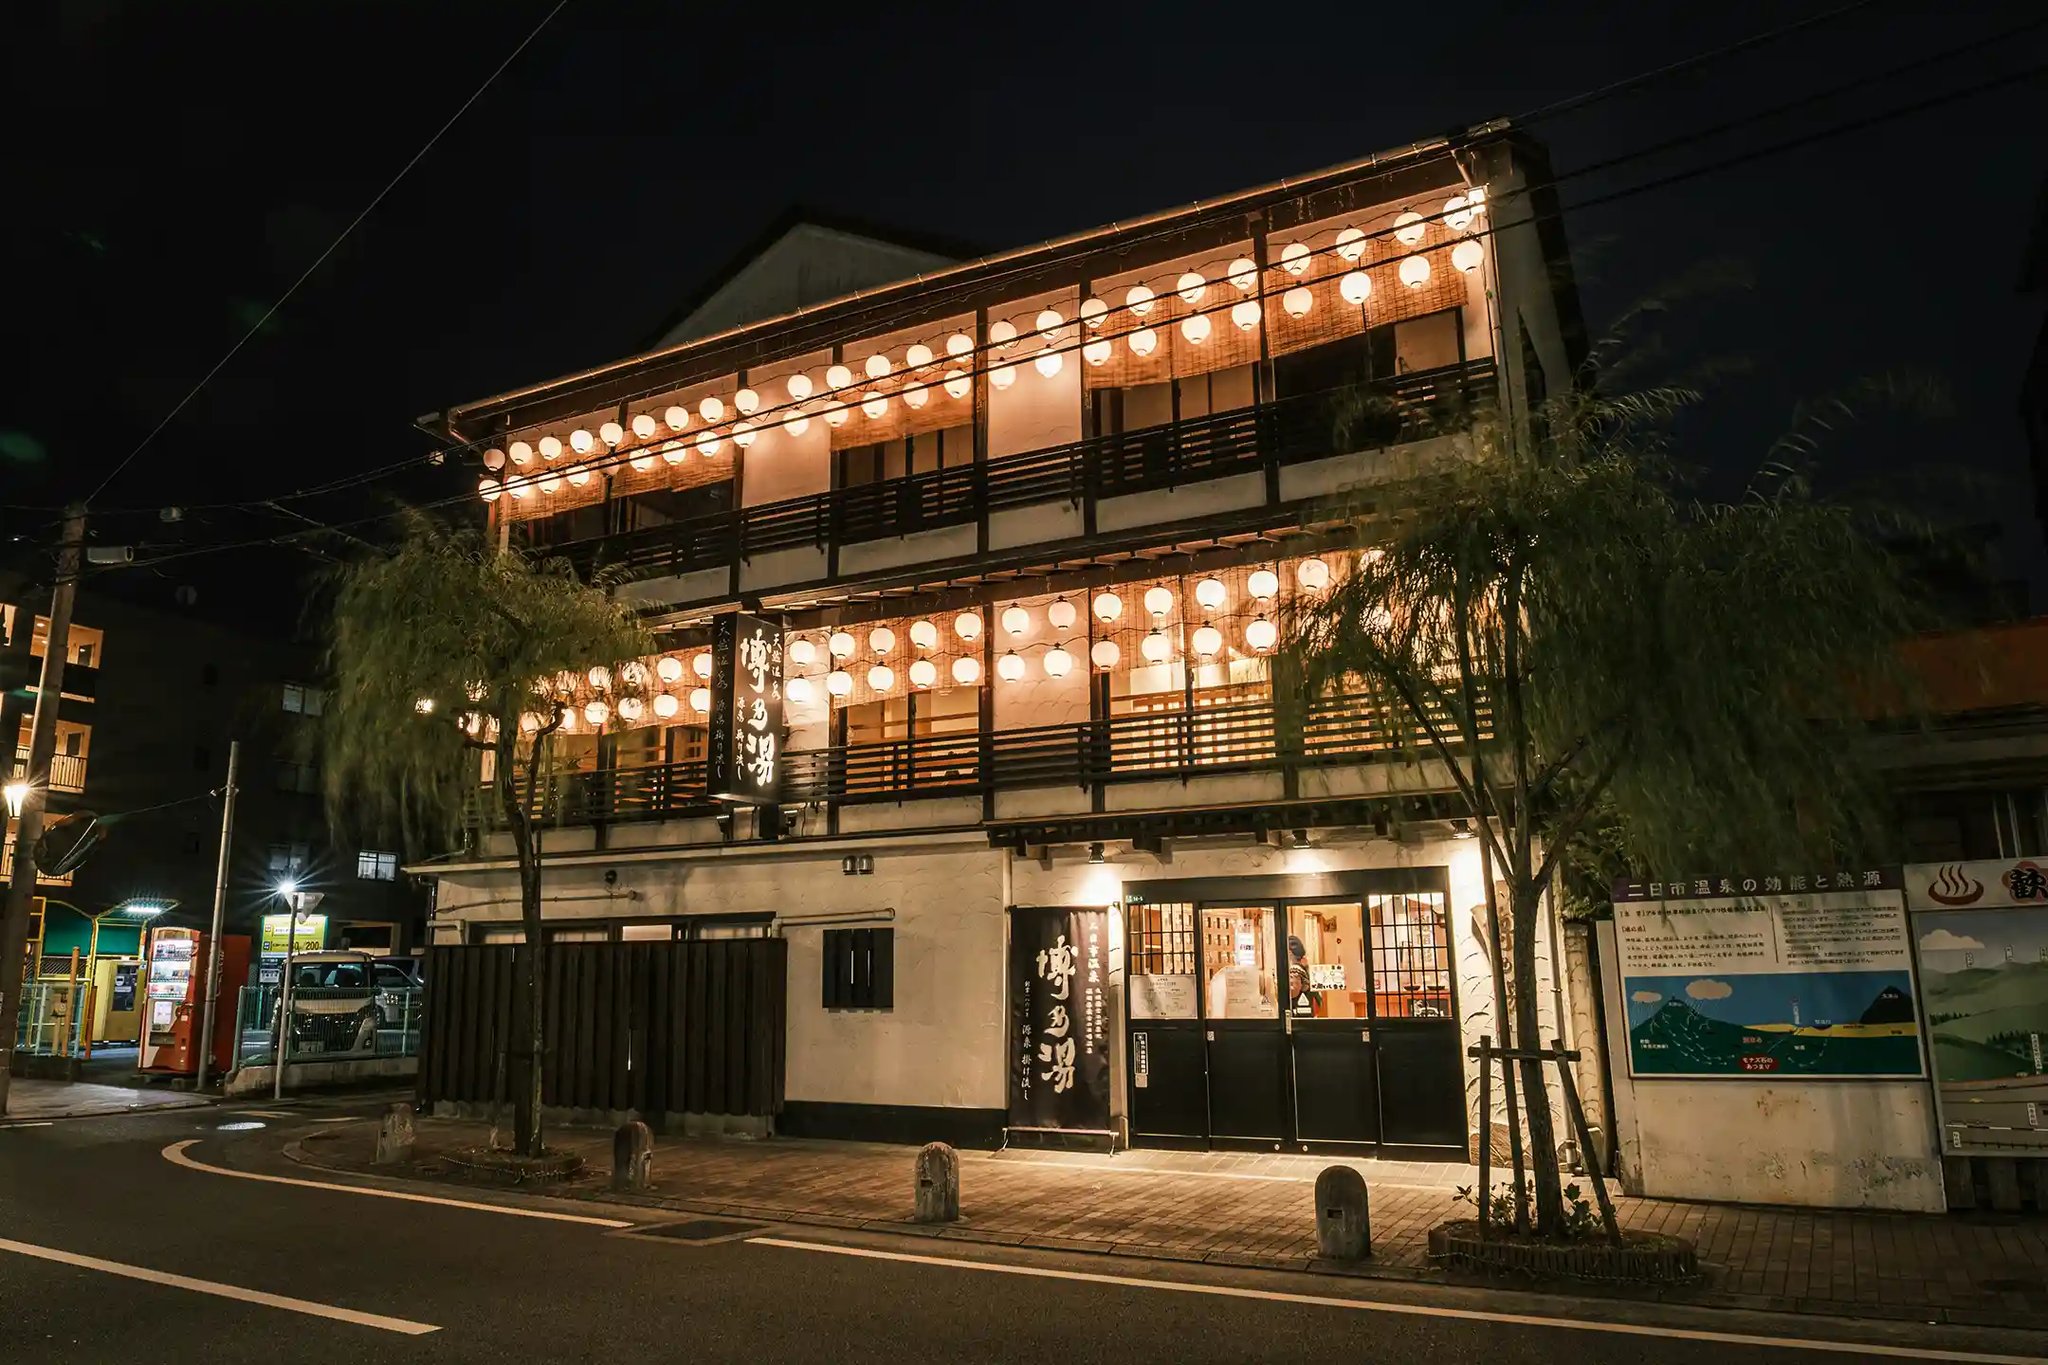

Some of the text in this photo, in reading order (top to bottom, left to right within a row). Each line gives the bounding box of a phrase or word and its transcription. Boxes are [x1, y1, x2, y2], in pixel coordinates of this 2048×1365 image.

[740, 628, 775, 787] 博多湯
[1628, 871, 1882, 897] 二日市温泉の効能と熱源
[305, 941, 320, 950] 200
[1036, 934, 1079, 1094] 博多湯
